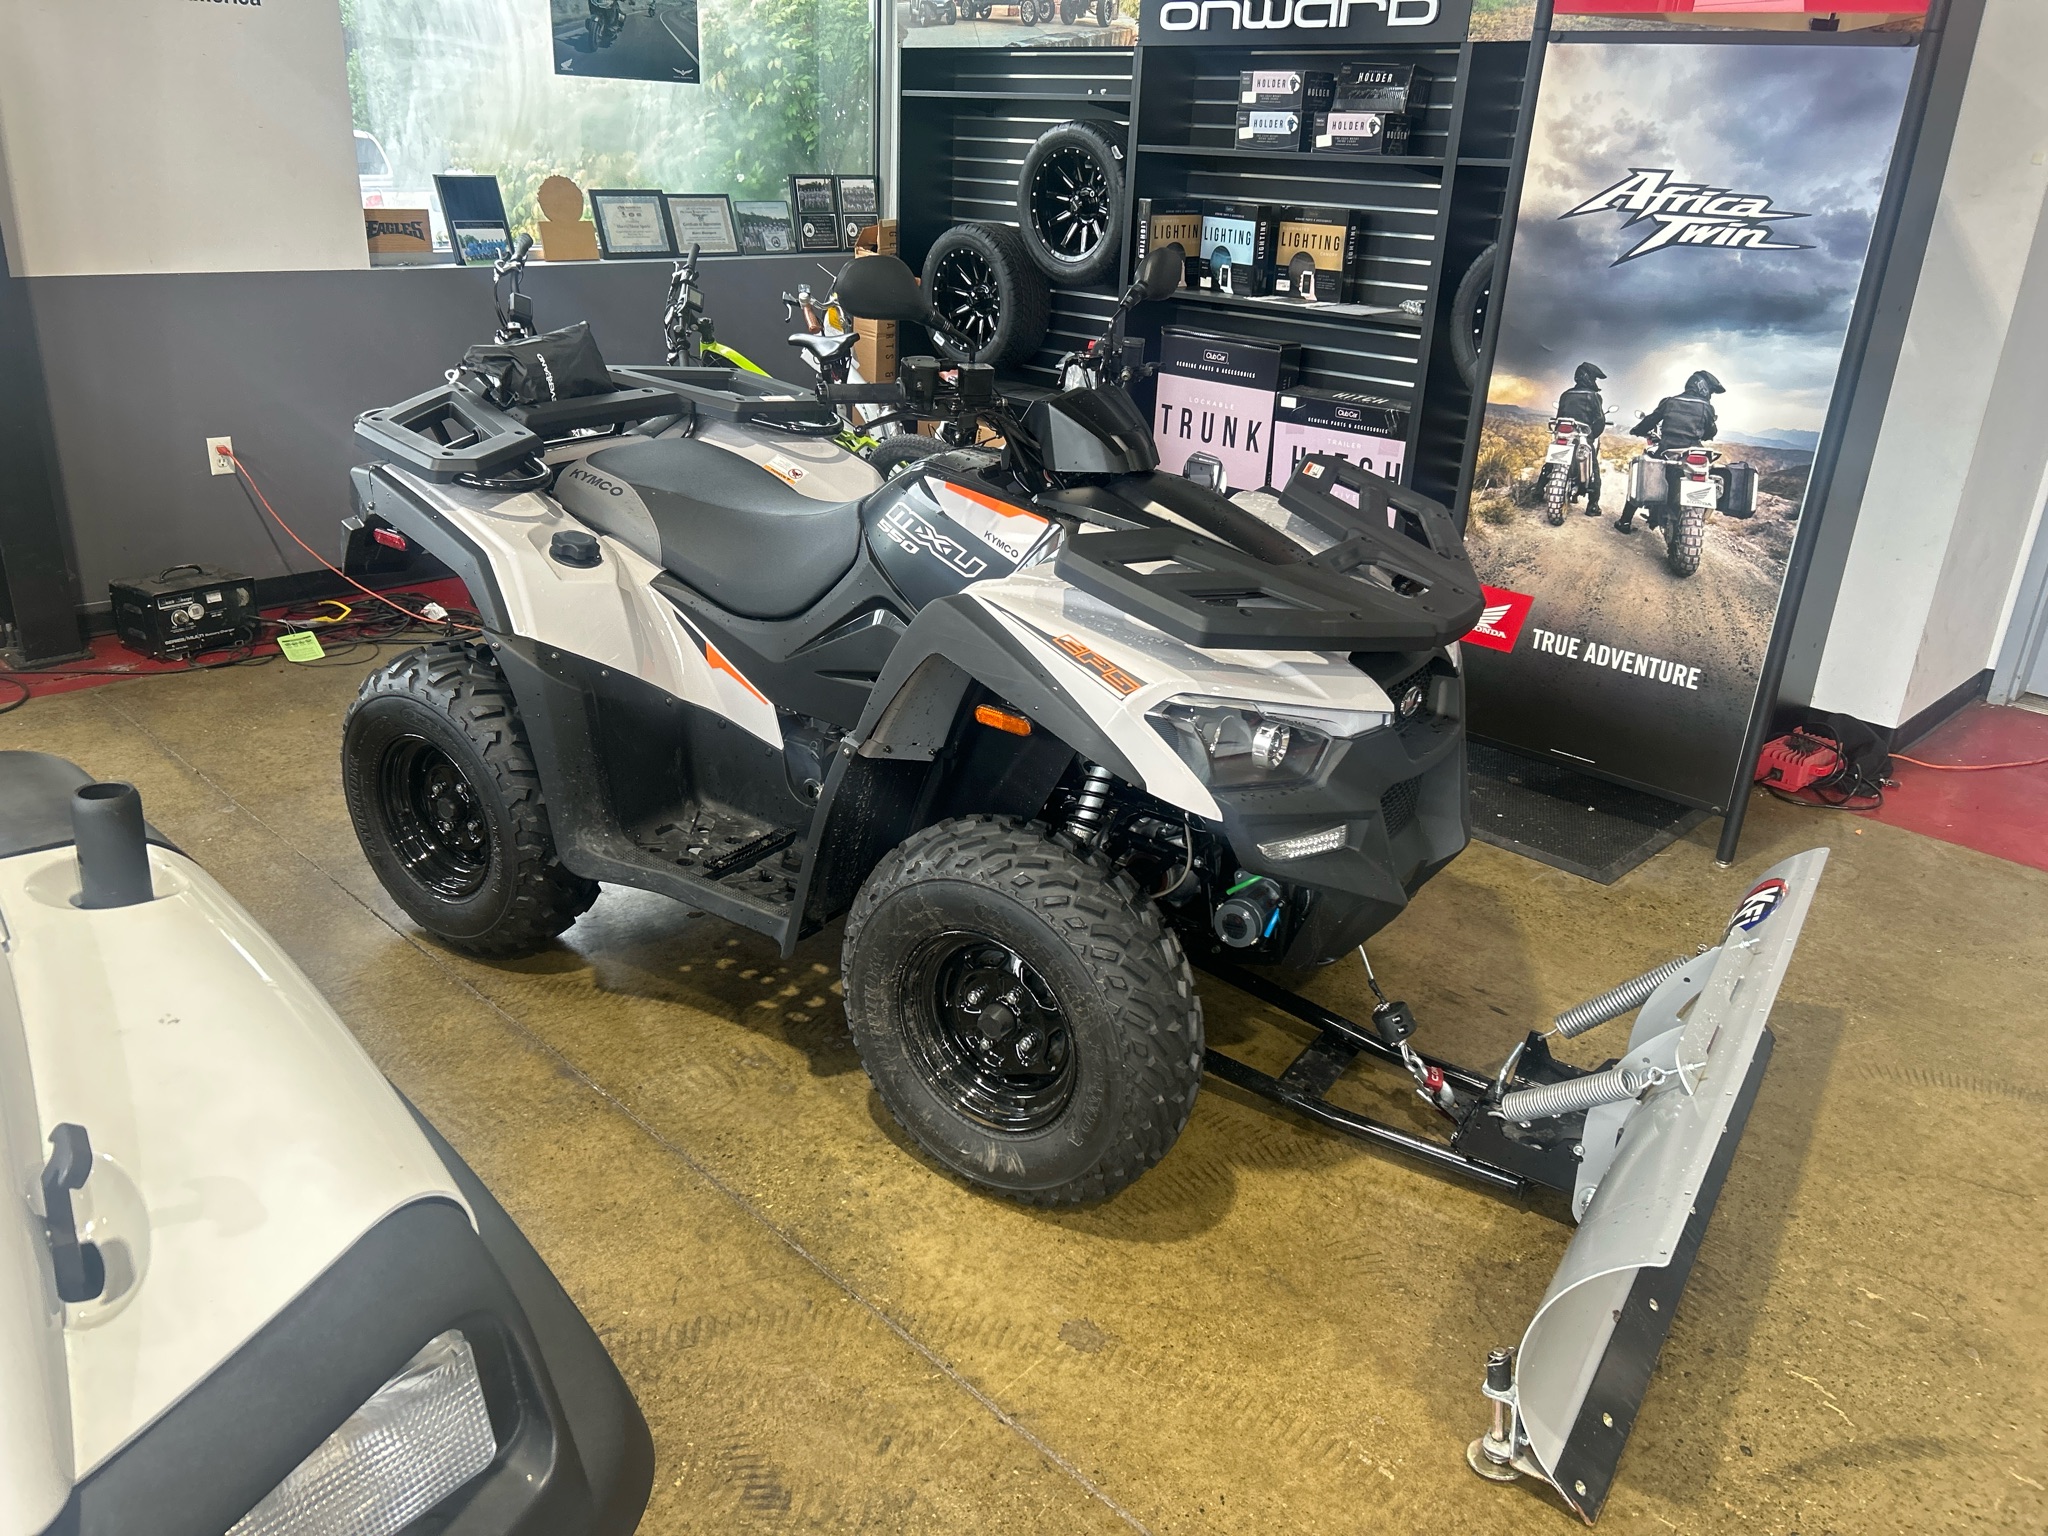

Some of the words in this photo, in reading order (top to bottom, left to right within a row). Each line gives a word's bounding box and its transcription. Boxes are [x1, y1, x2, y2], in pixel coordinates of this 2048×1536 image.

[1257, 78, 1286, 88] HOLDER
[1357, 72, 1393, 83] HOLDER
[1307, 88, 1330, 97] HOLDER
[1253, 119, 1284, 129] HOLDER
[1331, 120, 1365, 130] HOLDER
[1386, 130, 1407, 140] HOLDER
[1558, 168, 1811, 229] Africa
[366, 221, 425, 241] EAGLES
[1139, 220, 1147, 259] LIGHTING
[1153, 224, 1199, 240] LIGHTIN
[1204, 226, 1252, 246] LIGHTING
[1257, 221, 1267, 260] LIGHTING
[1281, 231, 1341, 251] LIGHTING
[1610, 213, 1815, 268] Twin
[1347, 224, 1357, 265] LIGHTING
[886, 323, 897, 361] ARTS
[1176, 360, 1197, 369] GENUINE
[1198, 364, 1214, 372] PARTS
[1221, 367, 1256, 379] ACCESSORIES
[1189, 396, 1235, 410] LOCKABLE
[1332, 391, 1390, 405] HITCH
[1161, 403, 1263, 453] TRUNK
[1307, 417, 1329, 425] GENUINE
[1330, 420, 1347, 428] PARTS
[1353, 424, 1388, 434] ACCESSORIES
[1327, 438, 1362, 449] TRAILER
[569, 468, 624, 496] KYMCO
[876, 517, 921, 555] 550
[885, 501, 988, 578] MXU
[983, 530, 1020, 559] KYMCO
[1472, 625, 1507, 639] ONDA
[1052, 633, 1143, 694] EPS
[1532, 628, 1581, 659] TRUE
[1583, 642, 1701, 690] ADVENTURE
